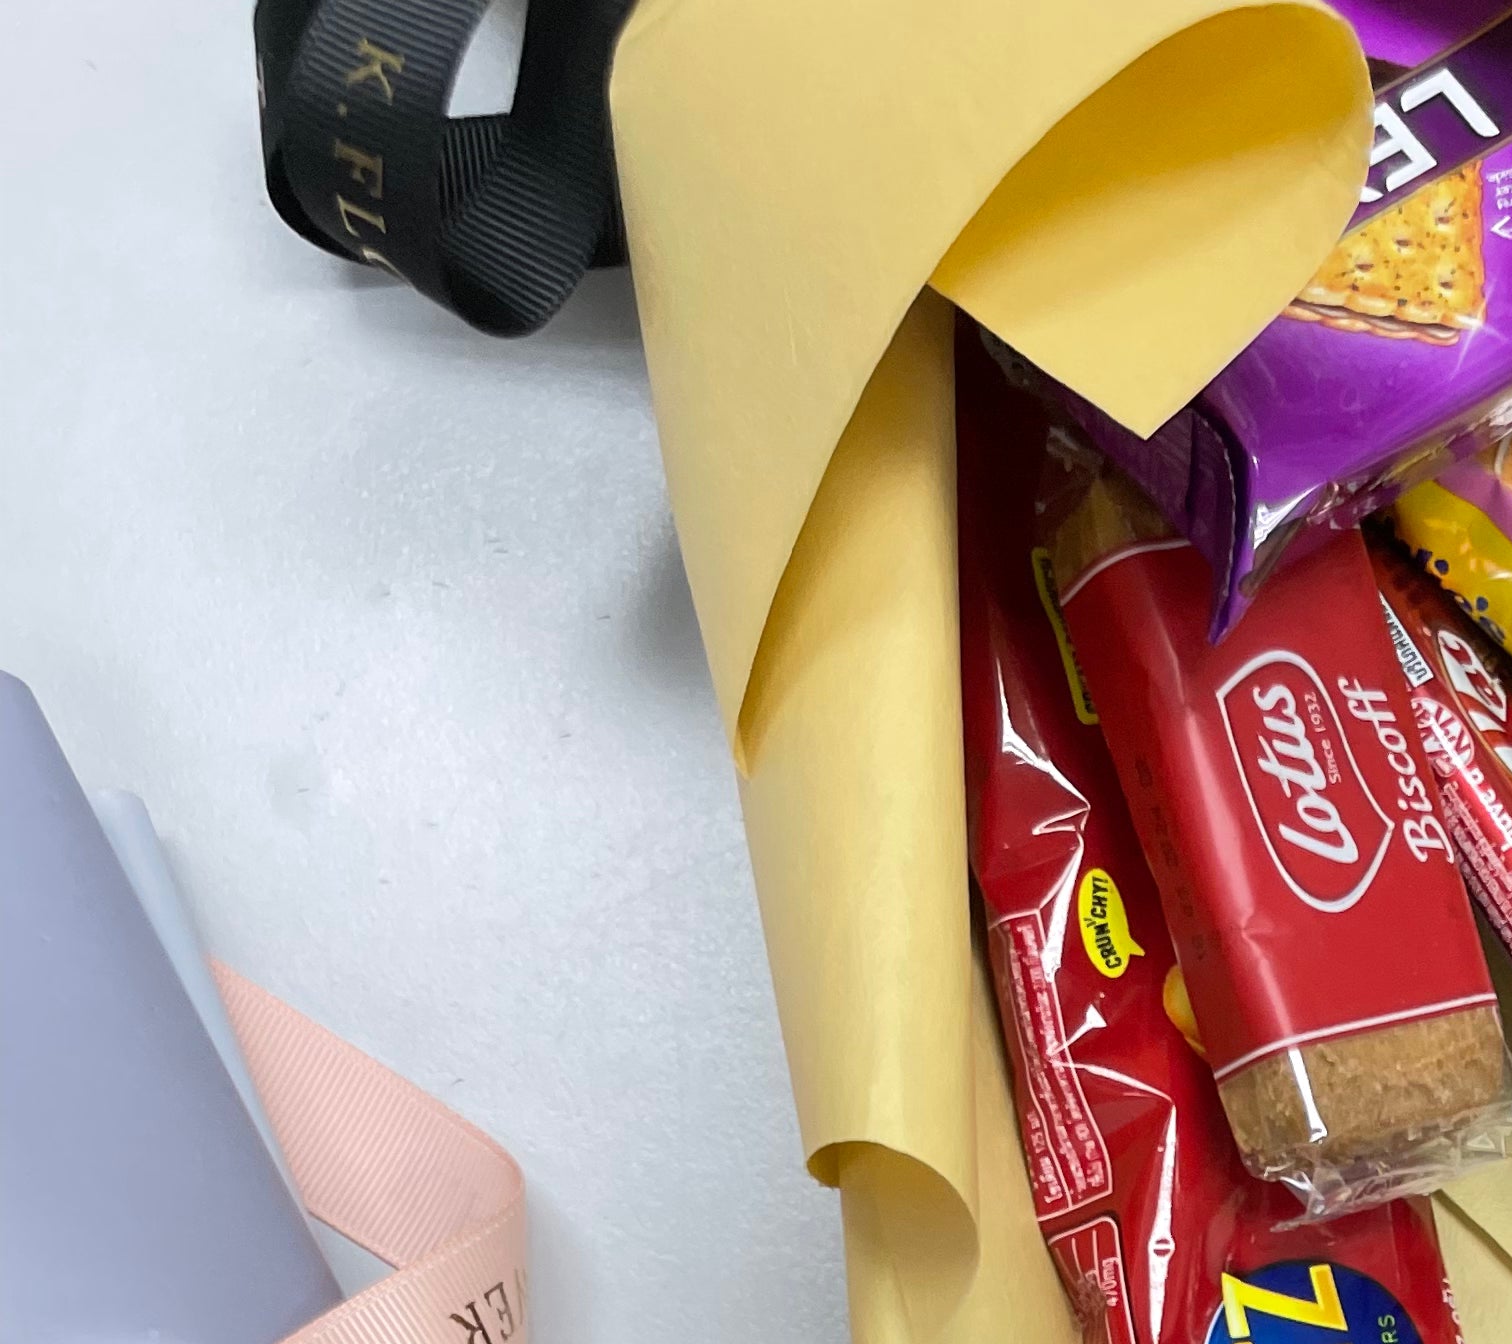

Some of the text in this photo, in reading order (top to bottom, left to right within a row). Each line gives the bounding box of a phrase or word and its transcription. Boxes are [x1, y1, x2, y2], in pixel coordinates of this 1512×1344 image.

[332, 38, 418, 290] K.FL
[1337, 676, 1454, 864] Biscoff
[1464, 765, 1487, 788] a
